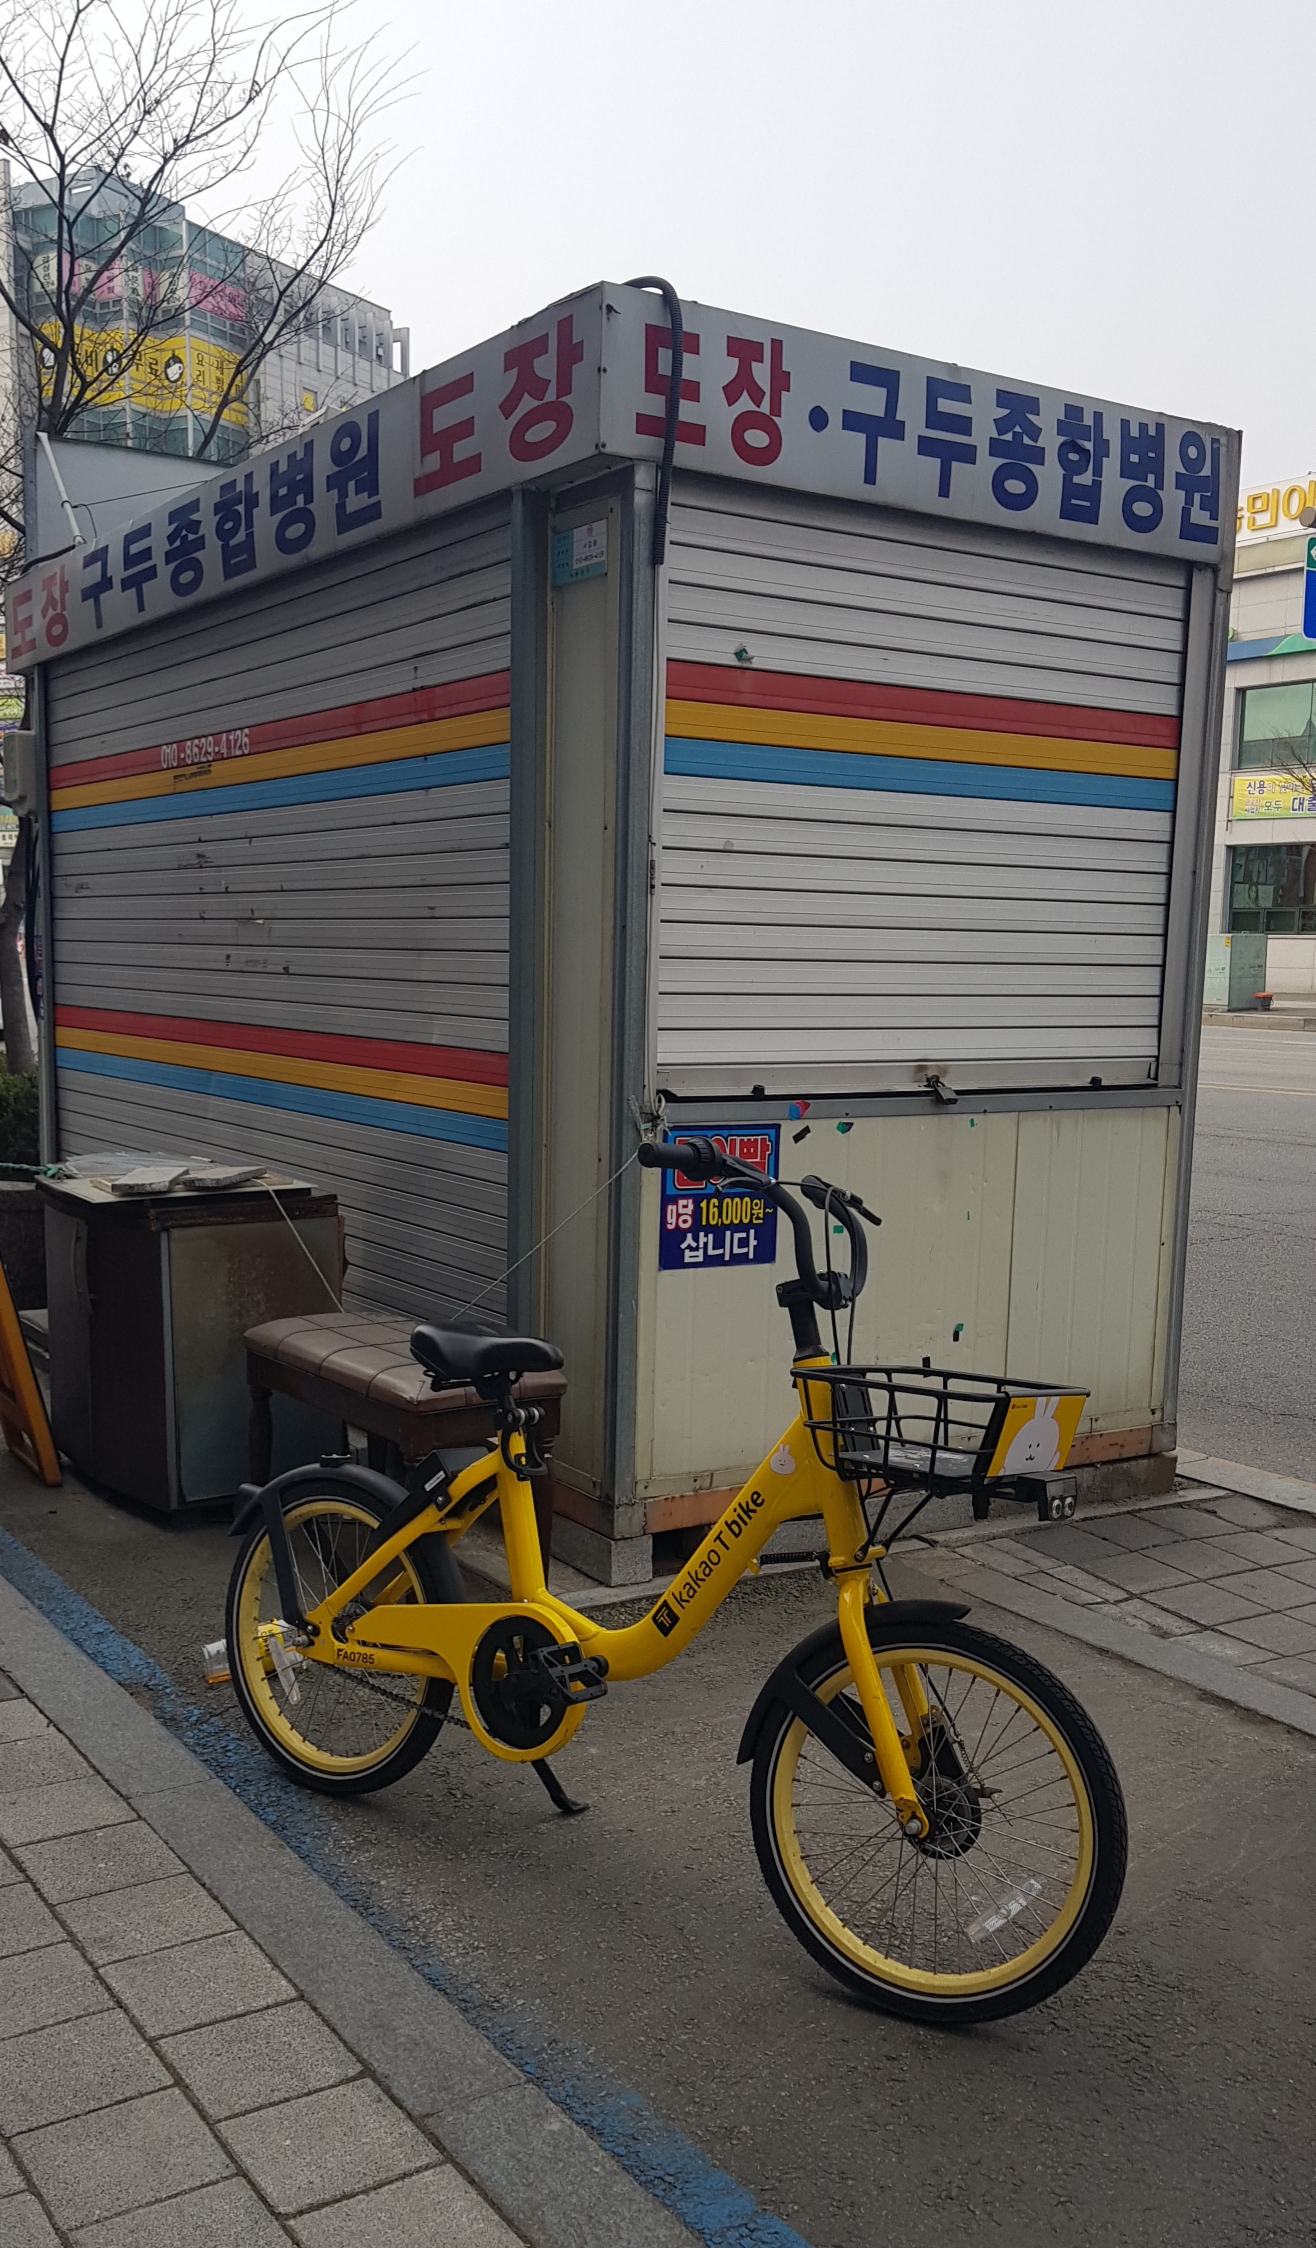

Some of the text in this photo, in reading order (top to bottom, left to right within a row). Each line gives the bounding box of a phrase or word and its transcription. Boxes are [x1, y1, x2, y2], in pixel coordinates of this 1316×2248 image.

[11, 313, 584, 660] 도장 구두종합병원 도장
[1263, 800, 1282, 812] 모두
[666, 1199, 694, 1230] g당
[680, 1229, 758, 1263] 삽니다
[671, 1549, 721, 1611] kakao
[713, 1530, 731, 1551] T
[724, 1490, 766, 1539] bike
[336, 1648, 375, 1665] FA0785
